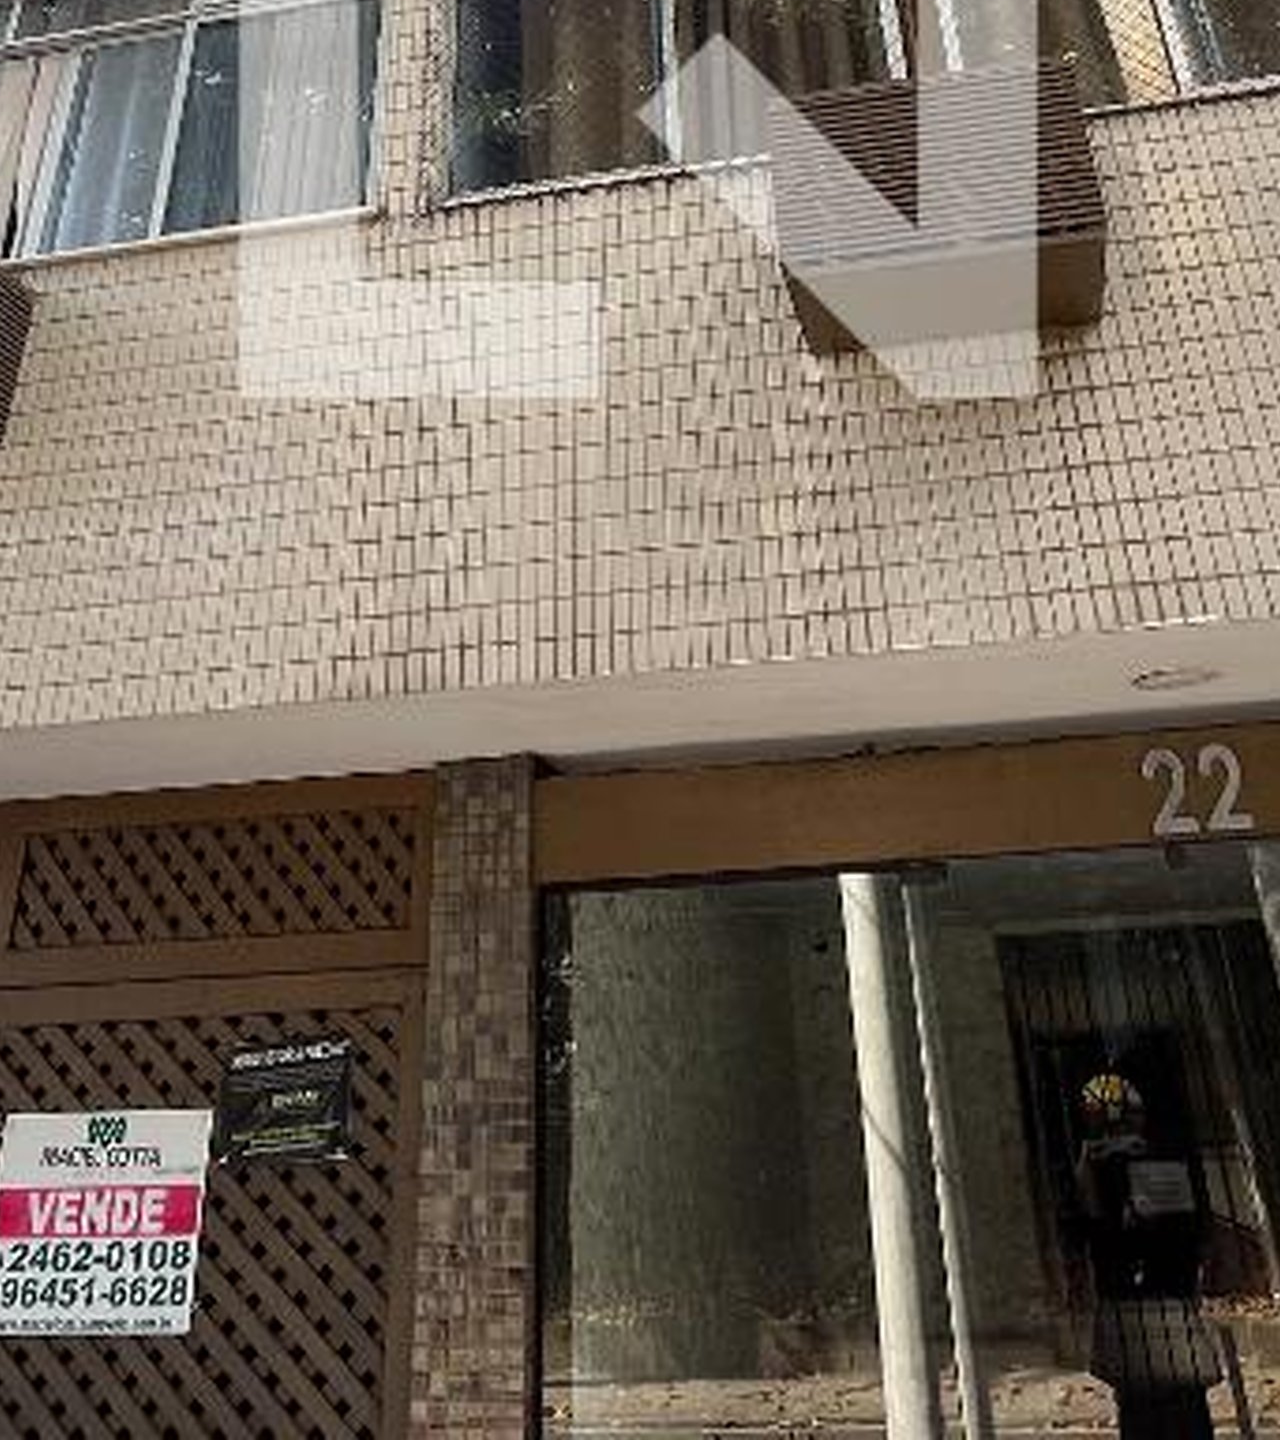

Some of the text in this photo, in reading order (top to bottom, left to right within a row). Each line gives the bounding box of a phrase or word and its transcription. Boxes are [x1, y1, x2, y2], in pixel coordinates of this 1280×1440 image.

[1141, 743, 1256, 836] 22
[28, 1189, 168, 1235] VENDE
[6, 1241, 191, 1272] 2462-0108
[1, 1276, 188, 1308] 96451-6628
